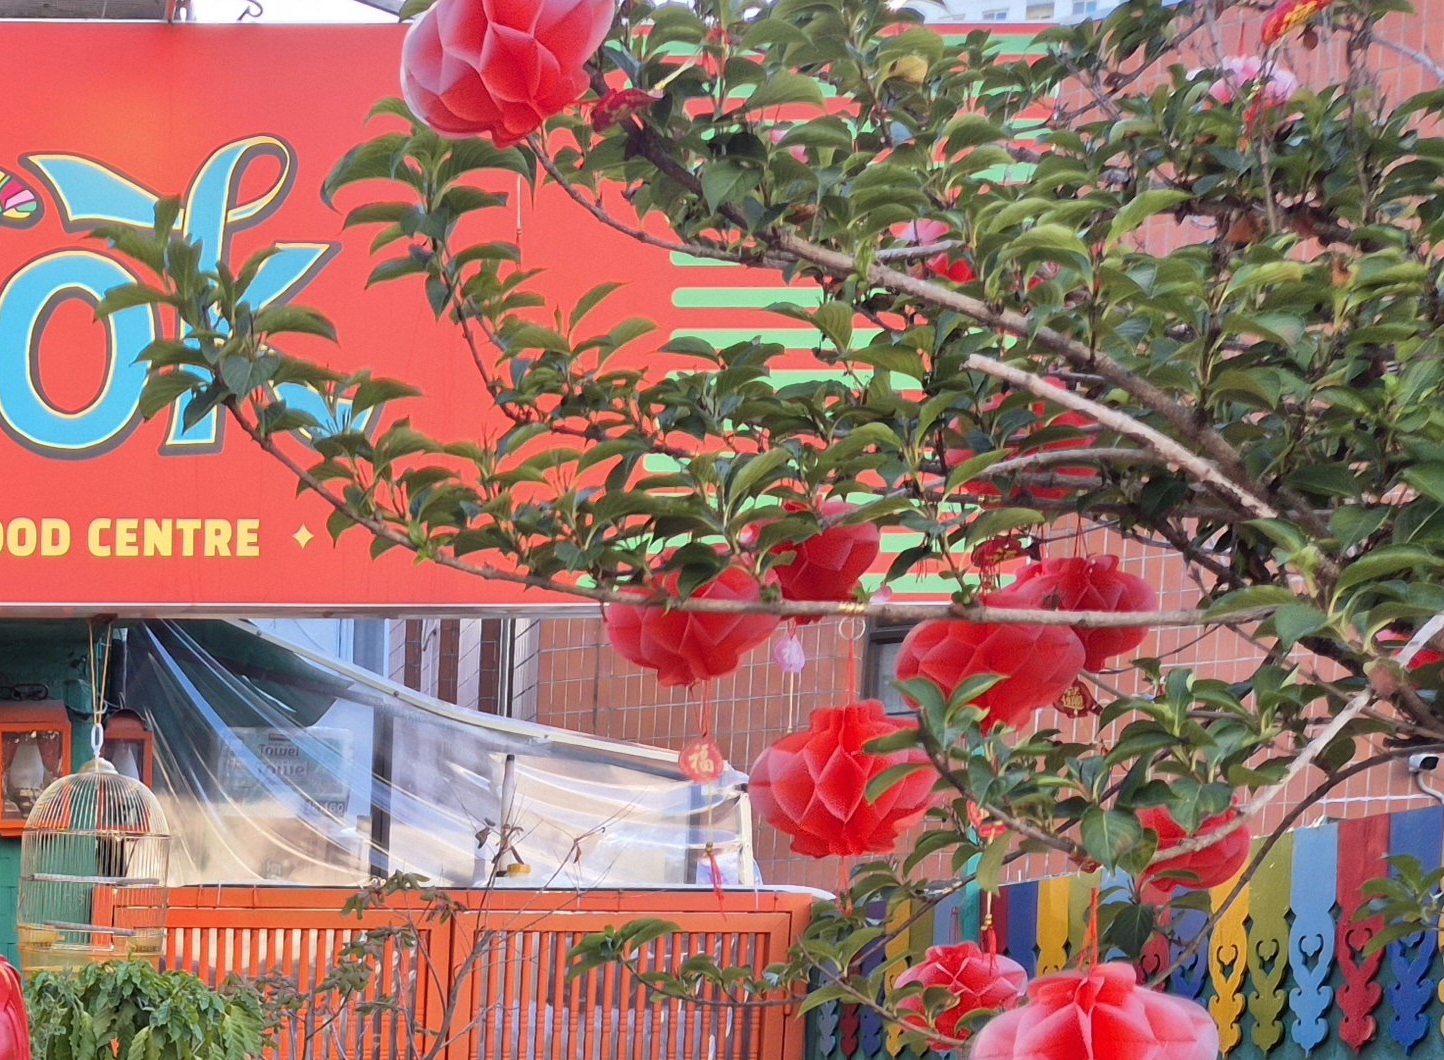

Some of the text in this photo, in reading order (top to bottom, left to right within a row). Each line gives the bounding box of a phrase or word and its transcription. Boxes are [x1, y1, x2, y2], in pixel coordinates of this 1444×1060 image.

[86, 517, 261, 557] CENTRE
[258, 743, 300, 758] Towel
[259, 760, 310, 779] owel
